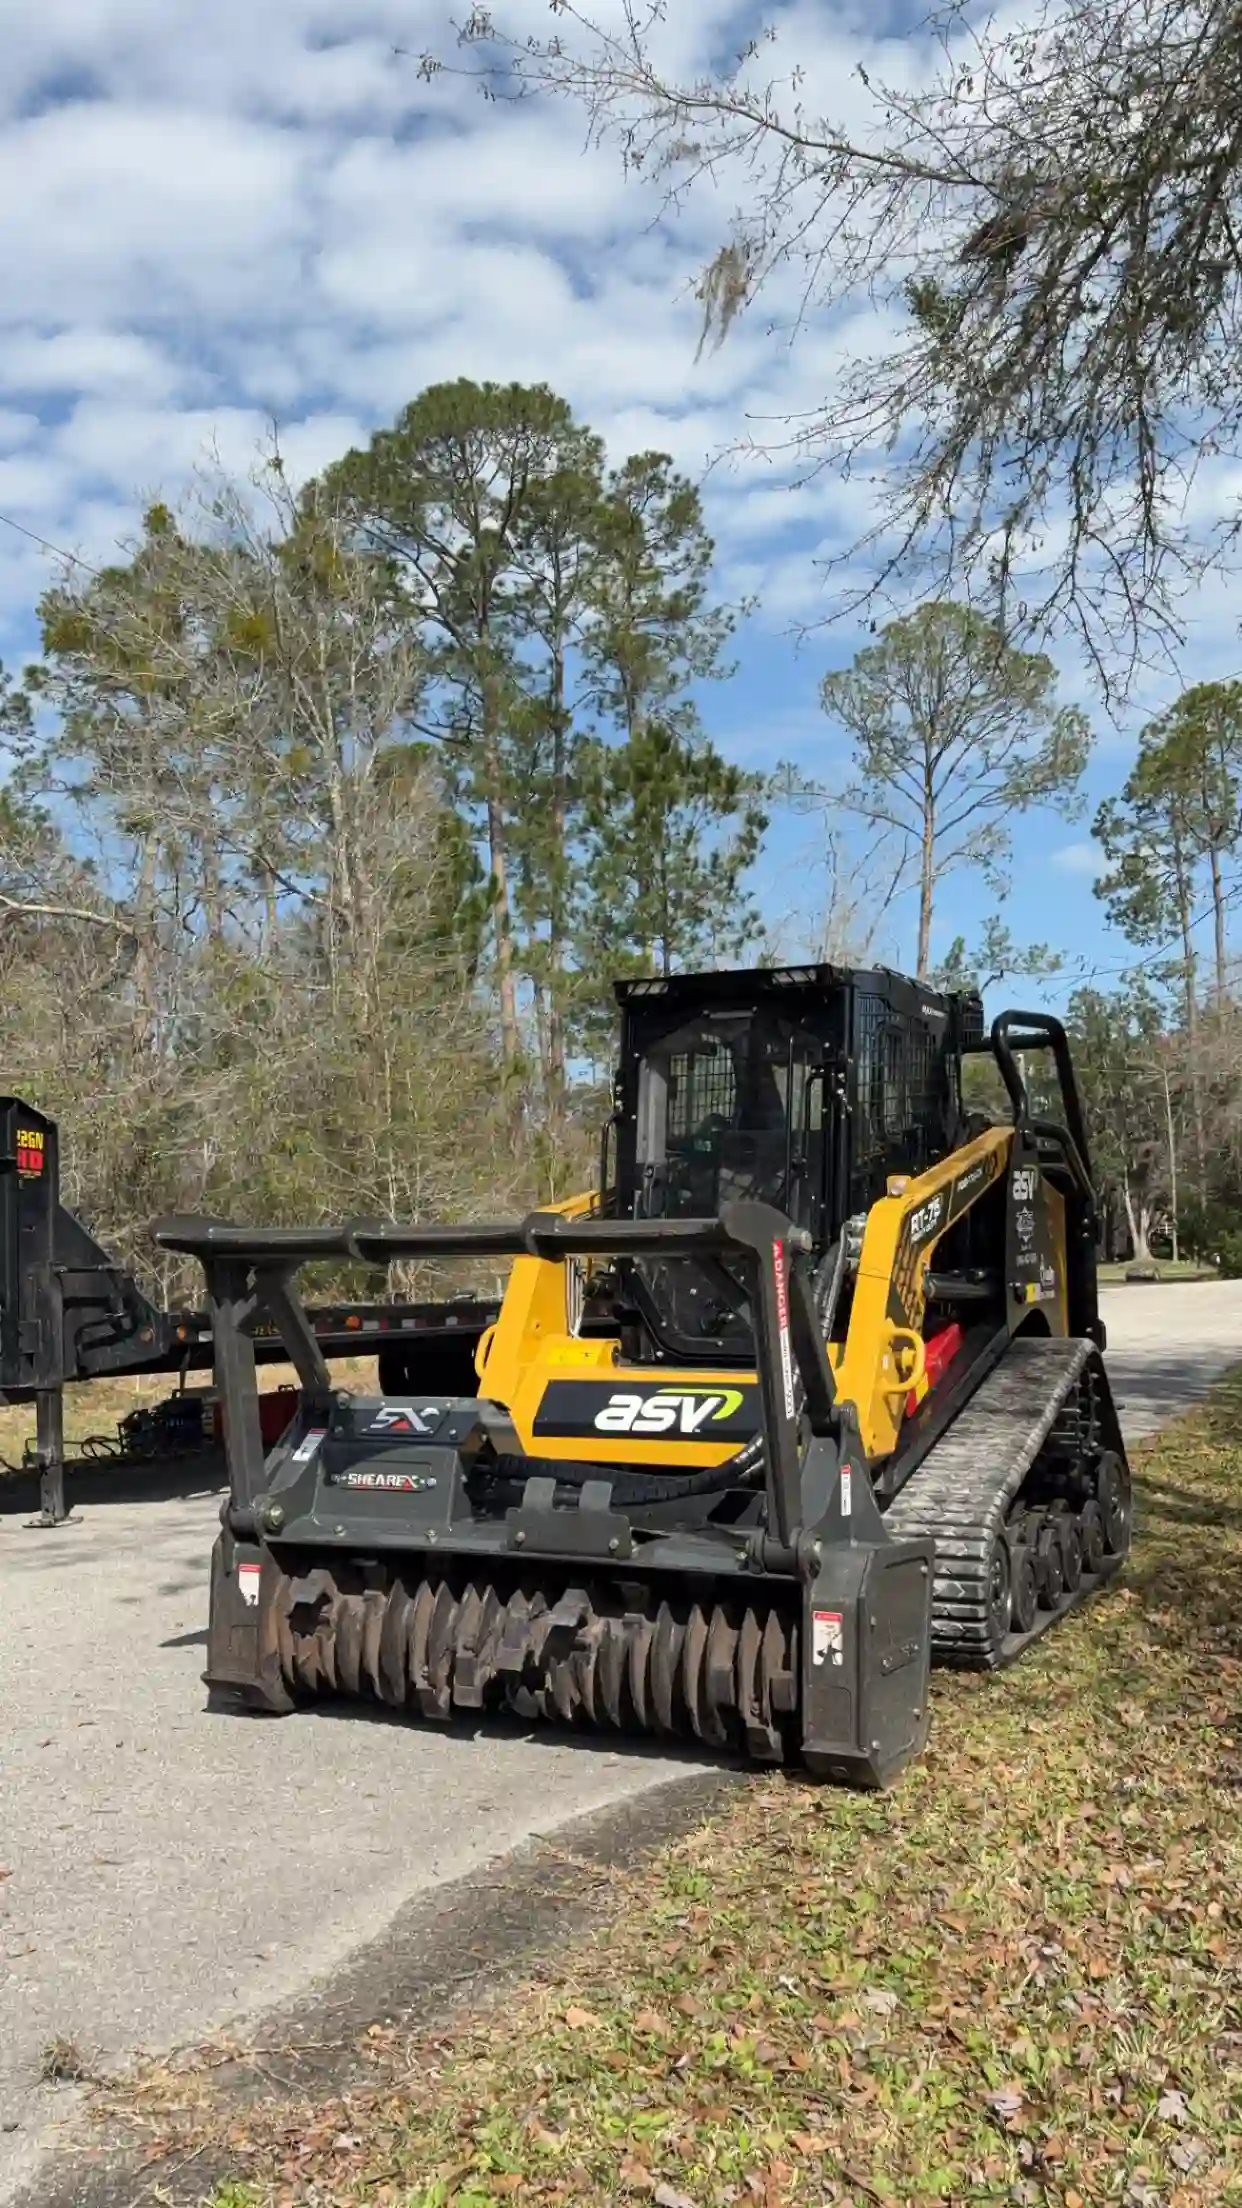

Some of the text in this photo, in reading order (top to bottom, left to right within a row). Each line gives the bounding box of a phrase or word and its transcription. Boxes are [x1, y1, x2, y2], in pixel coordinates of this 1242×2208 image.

[774, 1259, 788, 1329] DANGER
[594, 1394, 723, 1433] asv
[347, 1473, 421, 1489] SHEAREX
